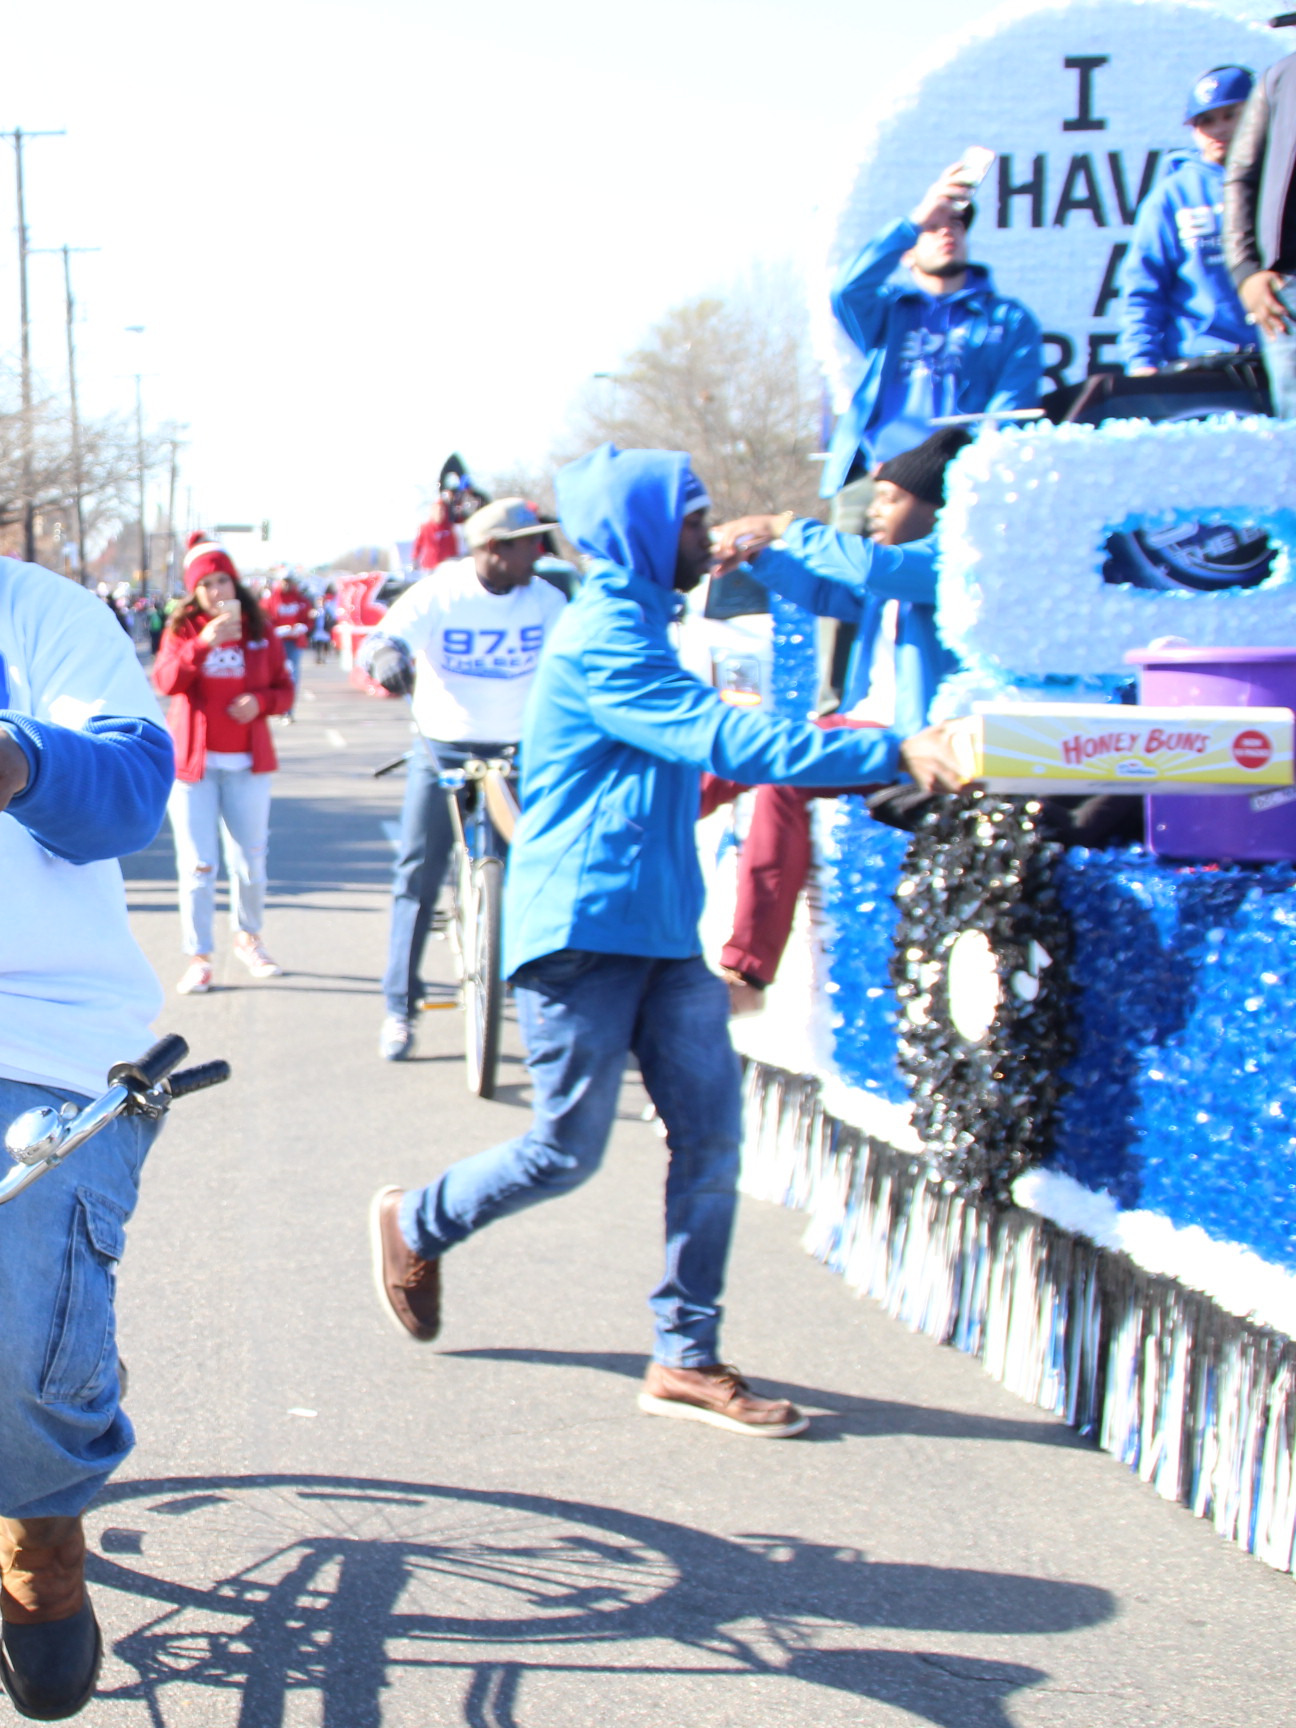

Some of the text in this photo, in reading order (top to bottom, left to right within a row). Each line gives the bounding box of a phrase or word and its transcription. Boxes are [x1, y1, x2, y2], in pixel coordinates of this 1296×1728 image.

[1063, 55, 1108, 131] I
[997, 148, 1174, 229] HAV
[1062, 728, 1211, 764] HONEY BUNS
